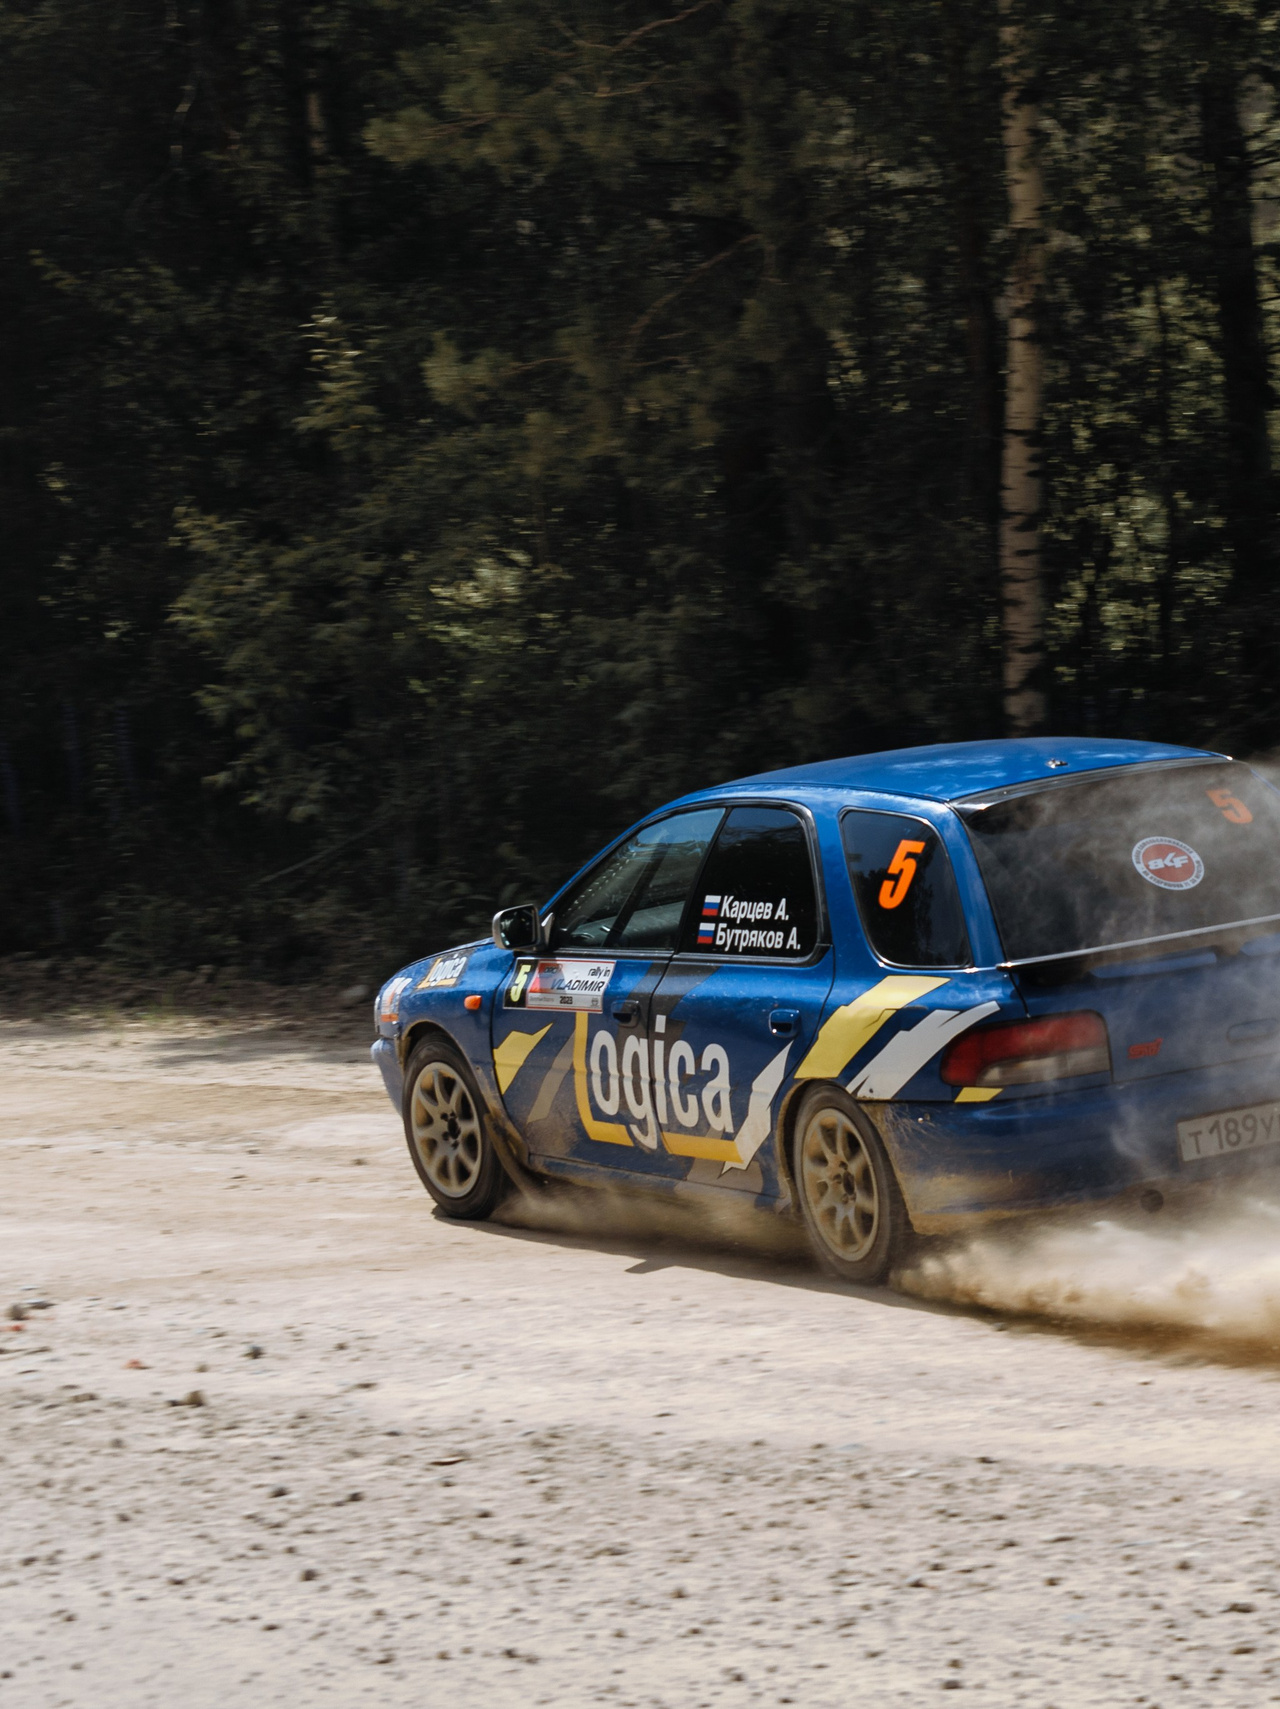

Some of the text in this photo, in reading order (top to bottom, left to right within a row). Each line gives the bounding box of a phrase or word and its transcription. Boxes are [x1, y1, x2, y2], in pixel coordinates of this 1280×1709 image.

[1205, 789, 1253, 824] 5
[878, 839, 926, 910] 5
[720, 895, 774, 924] Карцев
[715, 923, 784, 952] Бутряков
[510, 964, 532, 1002] 5
[550, 978, 606, 993] VLADIMIR
[588, 966, 611, 979] rally in
[559, 996, 573, 1004] 2023
